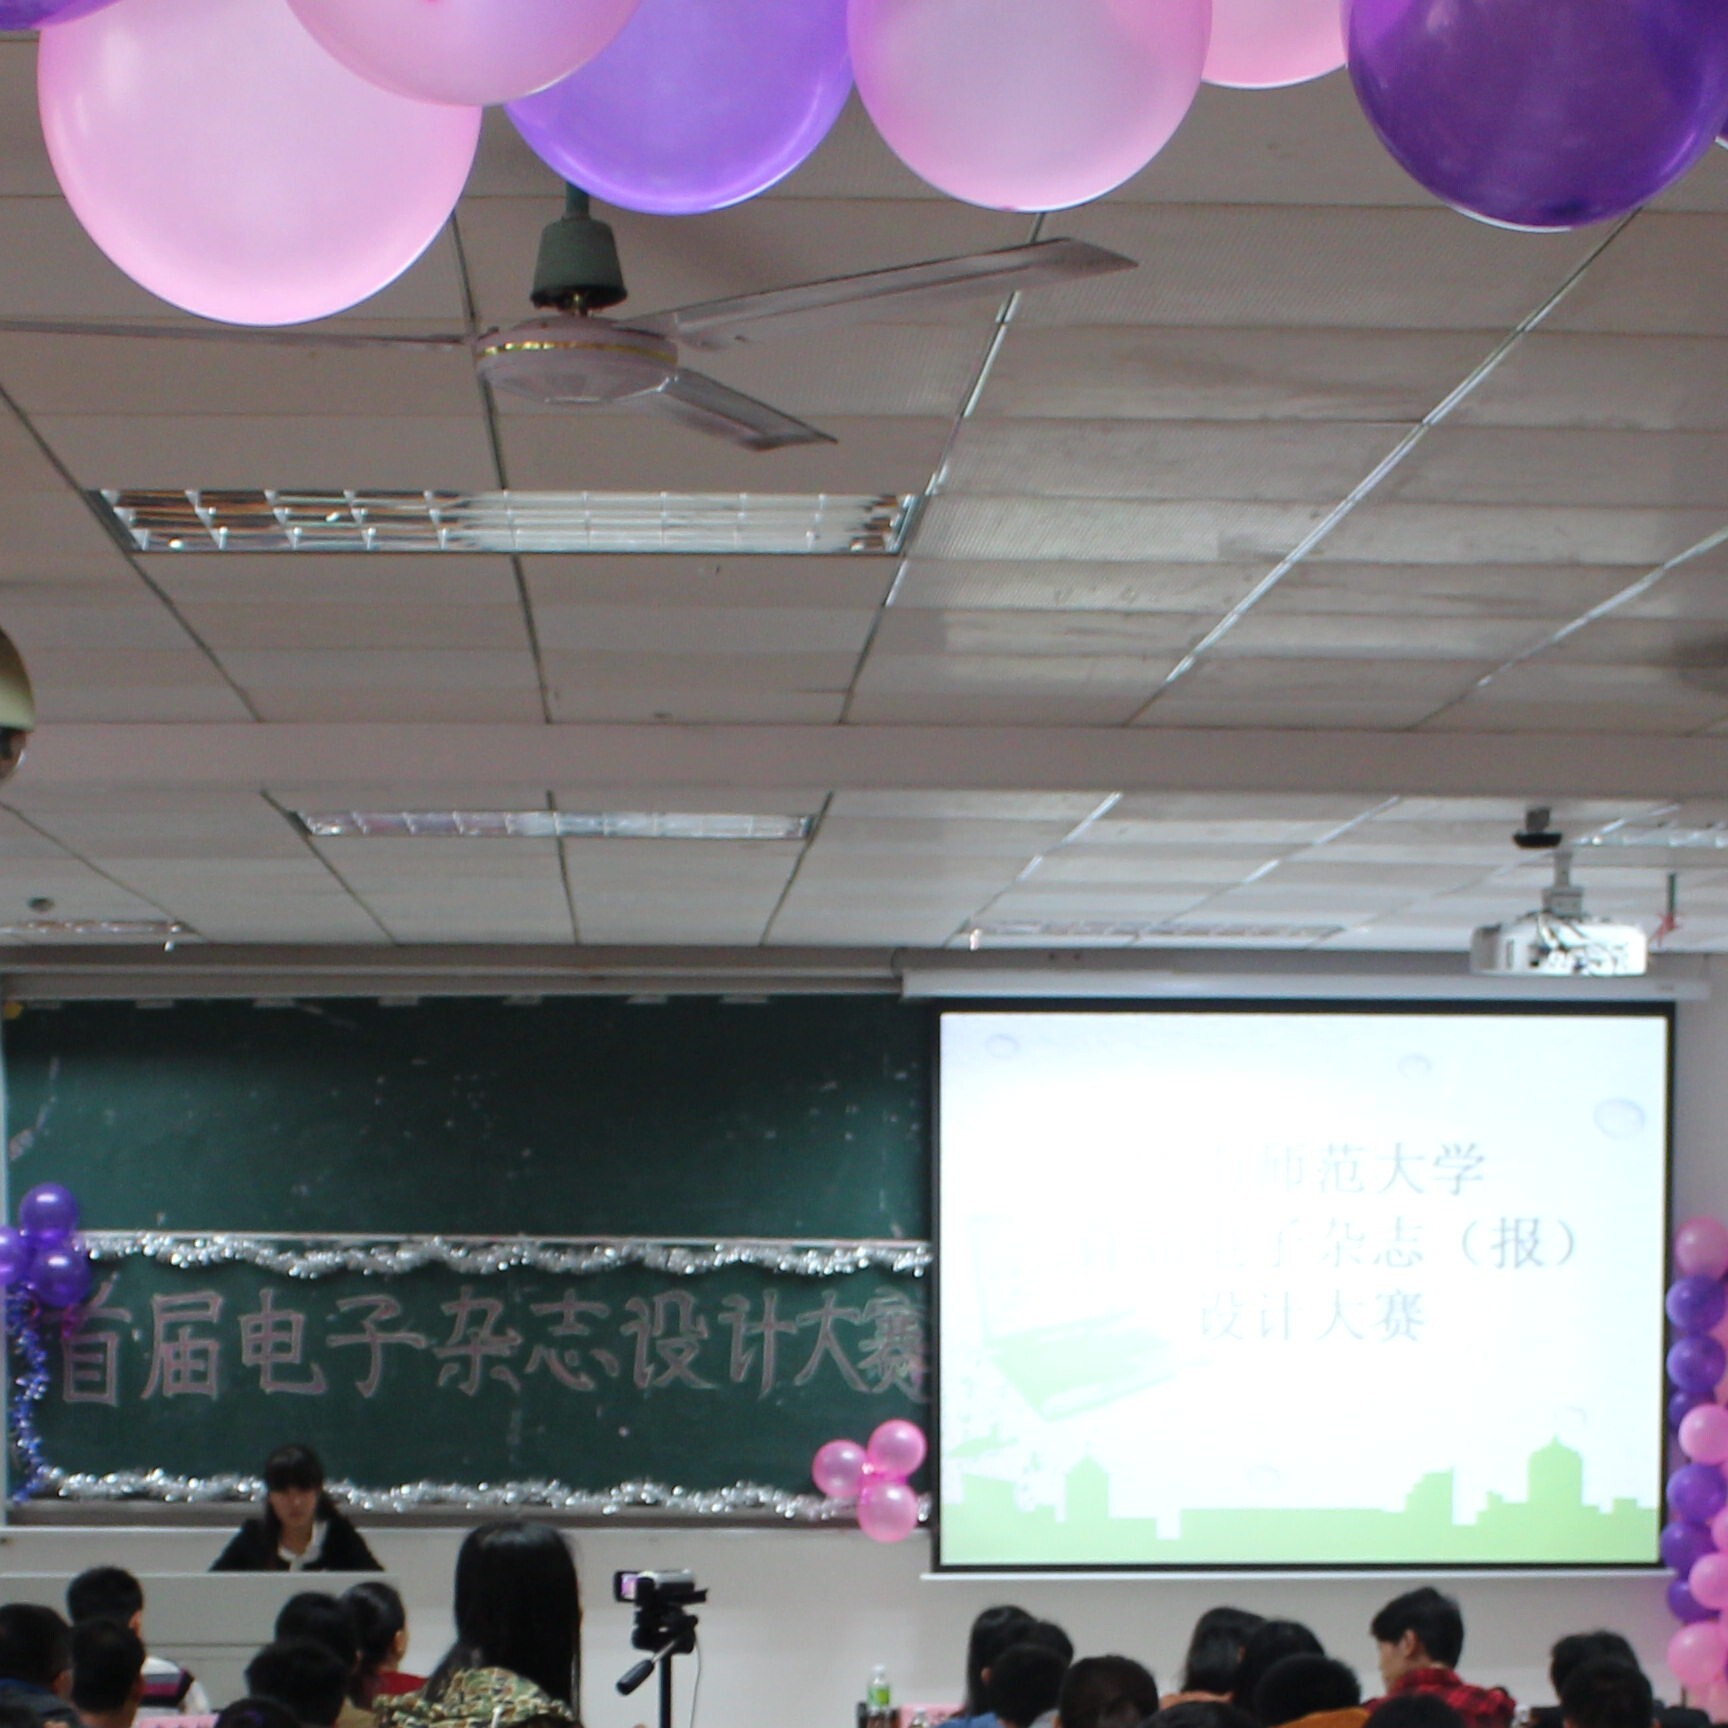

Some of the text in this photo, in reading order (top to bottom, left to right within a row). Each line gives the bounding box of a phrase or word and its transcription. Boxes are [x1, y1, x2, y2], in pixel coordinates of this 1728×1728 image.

[46, 1279, 928, 1407] 首届电子杂志设计大赛
